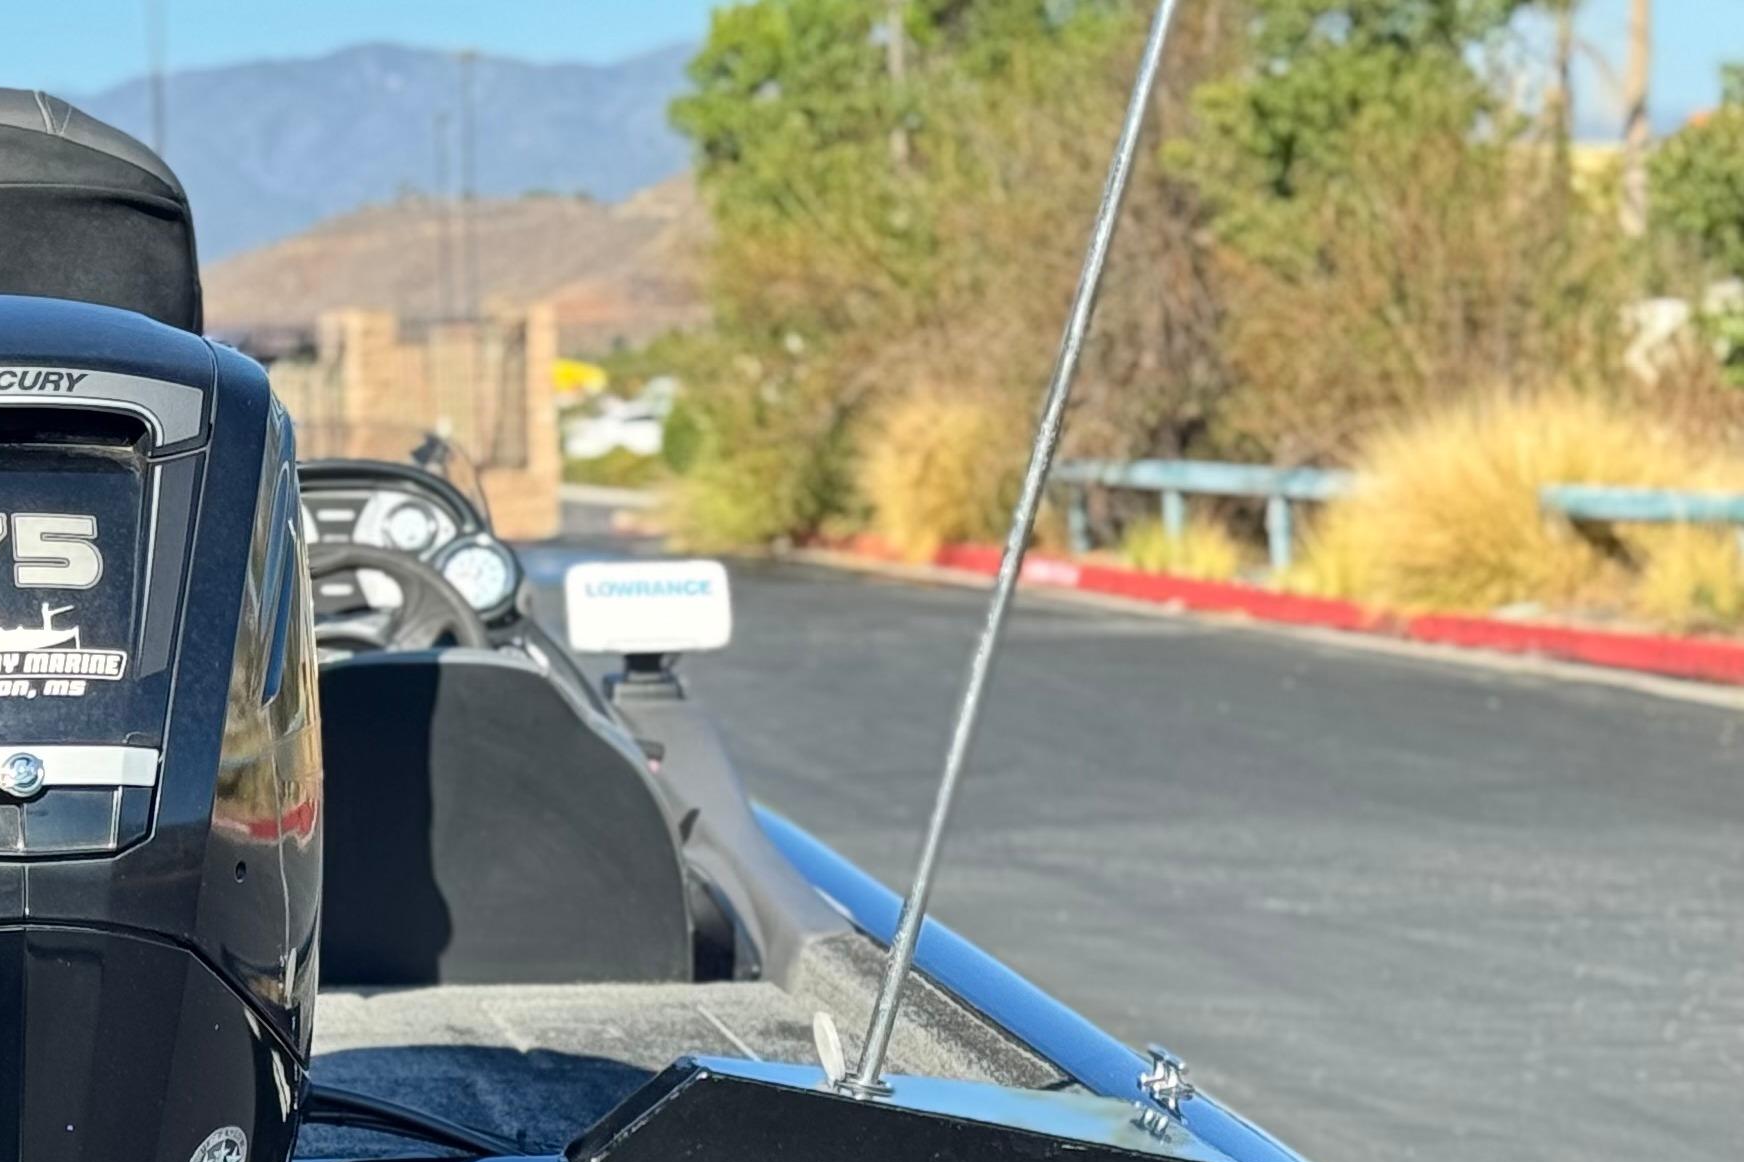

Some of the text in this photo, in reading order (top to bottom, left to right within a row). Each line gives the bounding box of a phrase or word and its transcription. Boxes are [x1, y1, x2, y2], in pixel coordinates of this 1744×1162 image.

[584, 578, 714, 598] LOWRANCE
[23, 652, 121, 676] MARINE
[43, 680, 87, 697] MS
